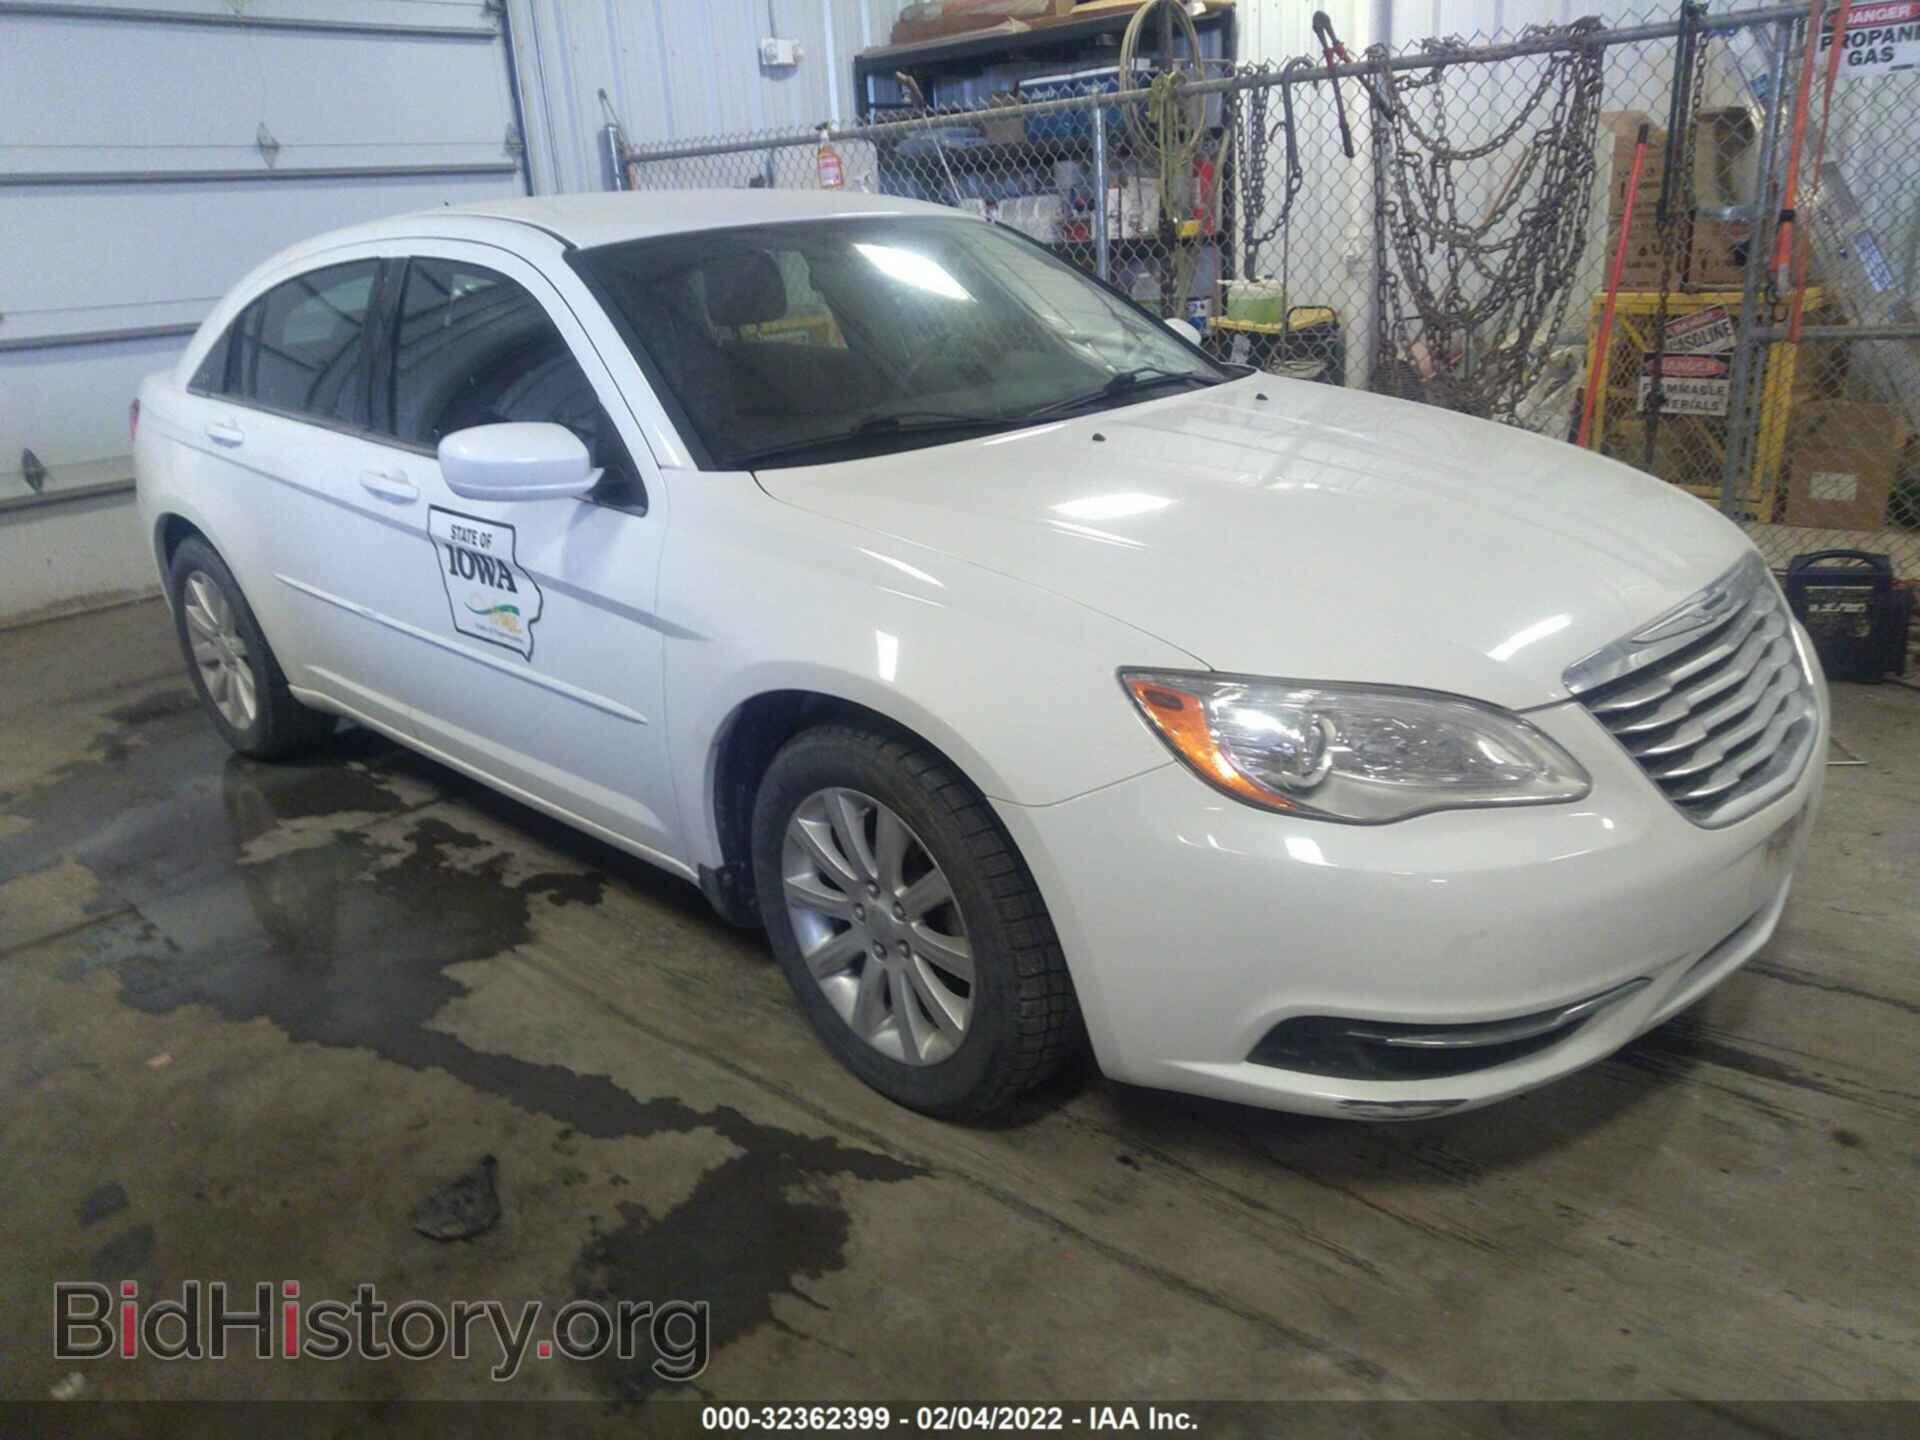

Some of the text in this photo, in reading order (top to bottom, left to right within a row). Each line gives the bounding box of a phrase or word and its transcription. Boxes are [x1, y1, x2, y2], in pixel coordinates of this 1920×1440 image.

[1847, 46, 1895, 66] GAS
[1643, 383, 1727, 397] FMMABLE
[451, 524, 493, 548] STATE OF
[443, 543, 518, 593] IOWA
